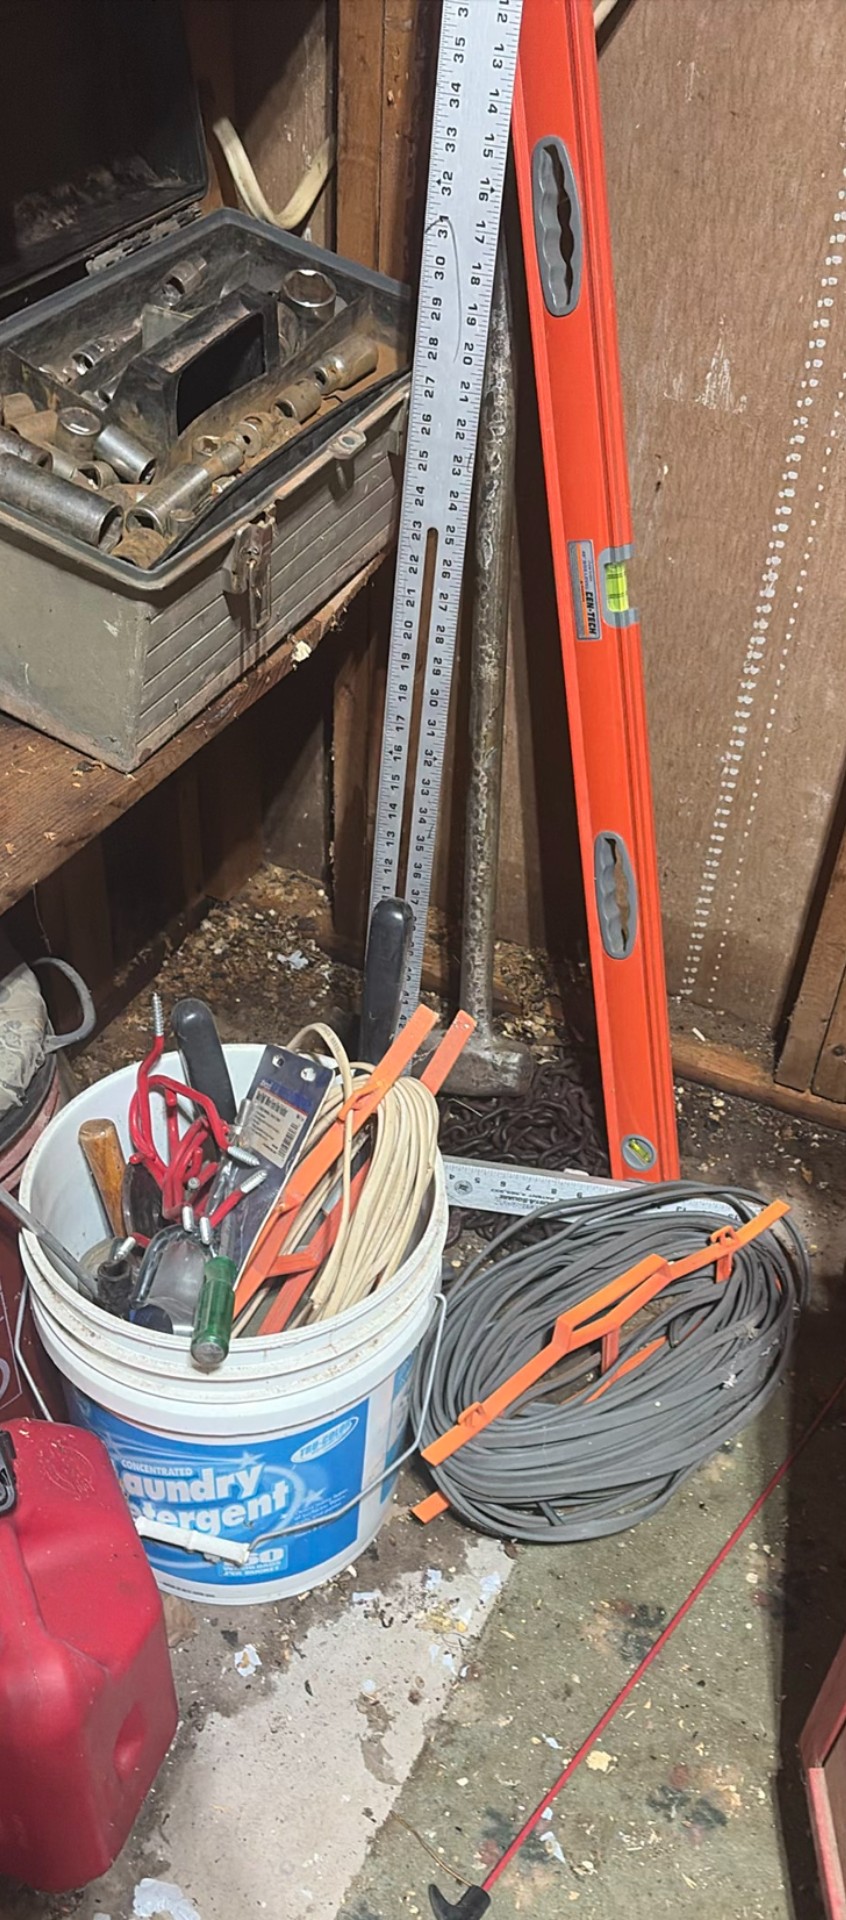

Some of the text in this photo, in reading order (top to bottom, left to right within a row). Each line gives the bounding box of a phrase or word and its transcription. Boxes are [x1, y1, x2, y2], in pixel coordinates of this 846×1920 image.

[497, 0, 509, 23] 12
[454, 37, 466, 63] 35
[492, 44, 504, 69] 13
[450, 82, 461, 108] 34
[488, 89, 500, 114] 14
[445, 127, 457, 153] 33
[483, 133, 494, 158] 15
[442, 171, 454, 196] 32
[478, 178, 490, 202] 16
[438, 216, 449, 238] 31
[475, 220, 486, 244] 17
[434, 256, 446, 280] 30
[470, 262, 482, 286] 18
[431, 297, 442, 321] 29
[466, 303, 478, 326] 19
[428, 337, 438, 360] 28
[463, 342, 474, 365] 20
[424, 377, 435, 398] 27
[459, 382, 470, 402] 21
[422, 414, 432, 436] 26
[456, 418, 466, 440] 22
[418, 451, 428, 472] 25
[452, 455, 462, 476] 23
[415, 486, 426, 507] 24
[448, 490, 458, 512] 24
[412, 520, 422, 541] 23
[445, 526, 455, 546] 25
[408, 554, 418, 574] 22
[442, 559, 452, 579] 26
[406, 588, 416, 608] 21
[438, 592, 448, 612] 27
[404, 620, 413, 640] 20
[436, 624, 446, 644] 28
[401, 653, 410, 671] 19
[432, 656, 442, 676] 29
[398, 684, 408, 702] 18
[430, 688, 440, 708] 30
[396, 715, 406, 732] 17
[427, 719, 436, 738] 31
[394, 744, 402, 762] 16
[424, 749, 433, 767] 32
[391, 774, 400, 790] 15
[421, 778, 430, 796] 33
[389, 803, 397, 818] 14
[418, 806, 428, 824] 34
[386, 831, 395, 846] 13
[416, 835, 425, 852] 35
[384, 858, 393, 874] 12
[413, 862, 422, 879] 36
[410, 889, 420, 905] 37
[121, 1460, 193, 1476] CONCENTRATED
[122, 1463, 264, 1502] aundry
[130, 1480, 288, 1536] etergent
